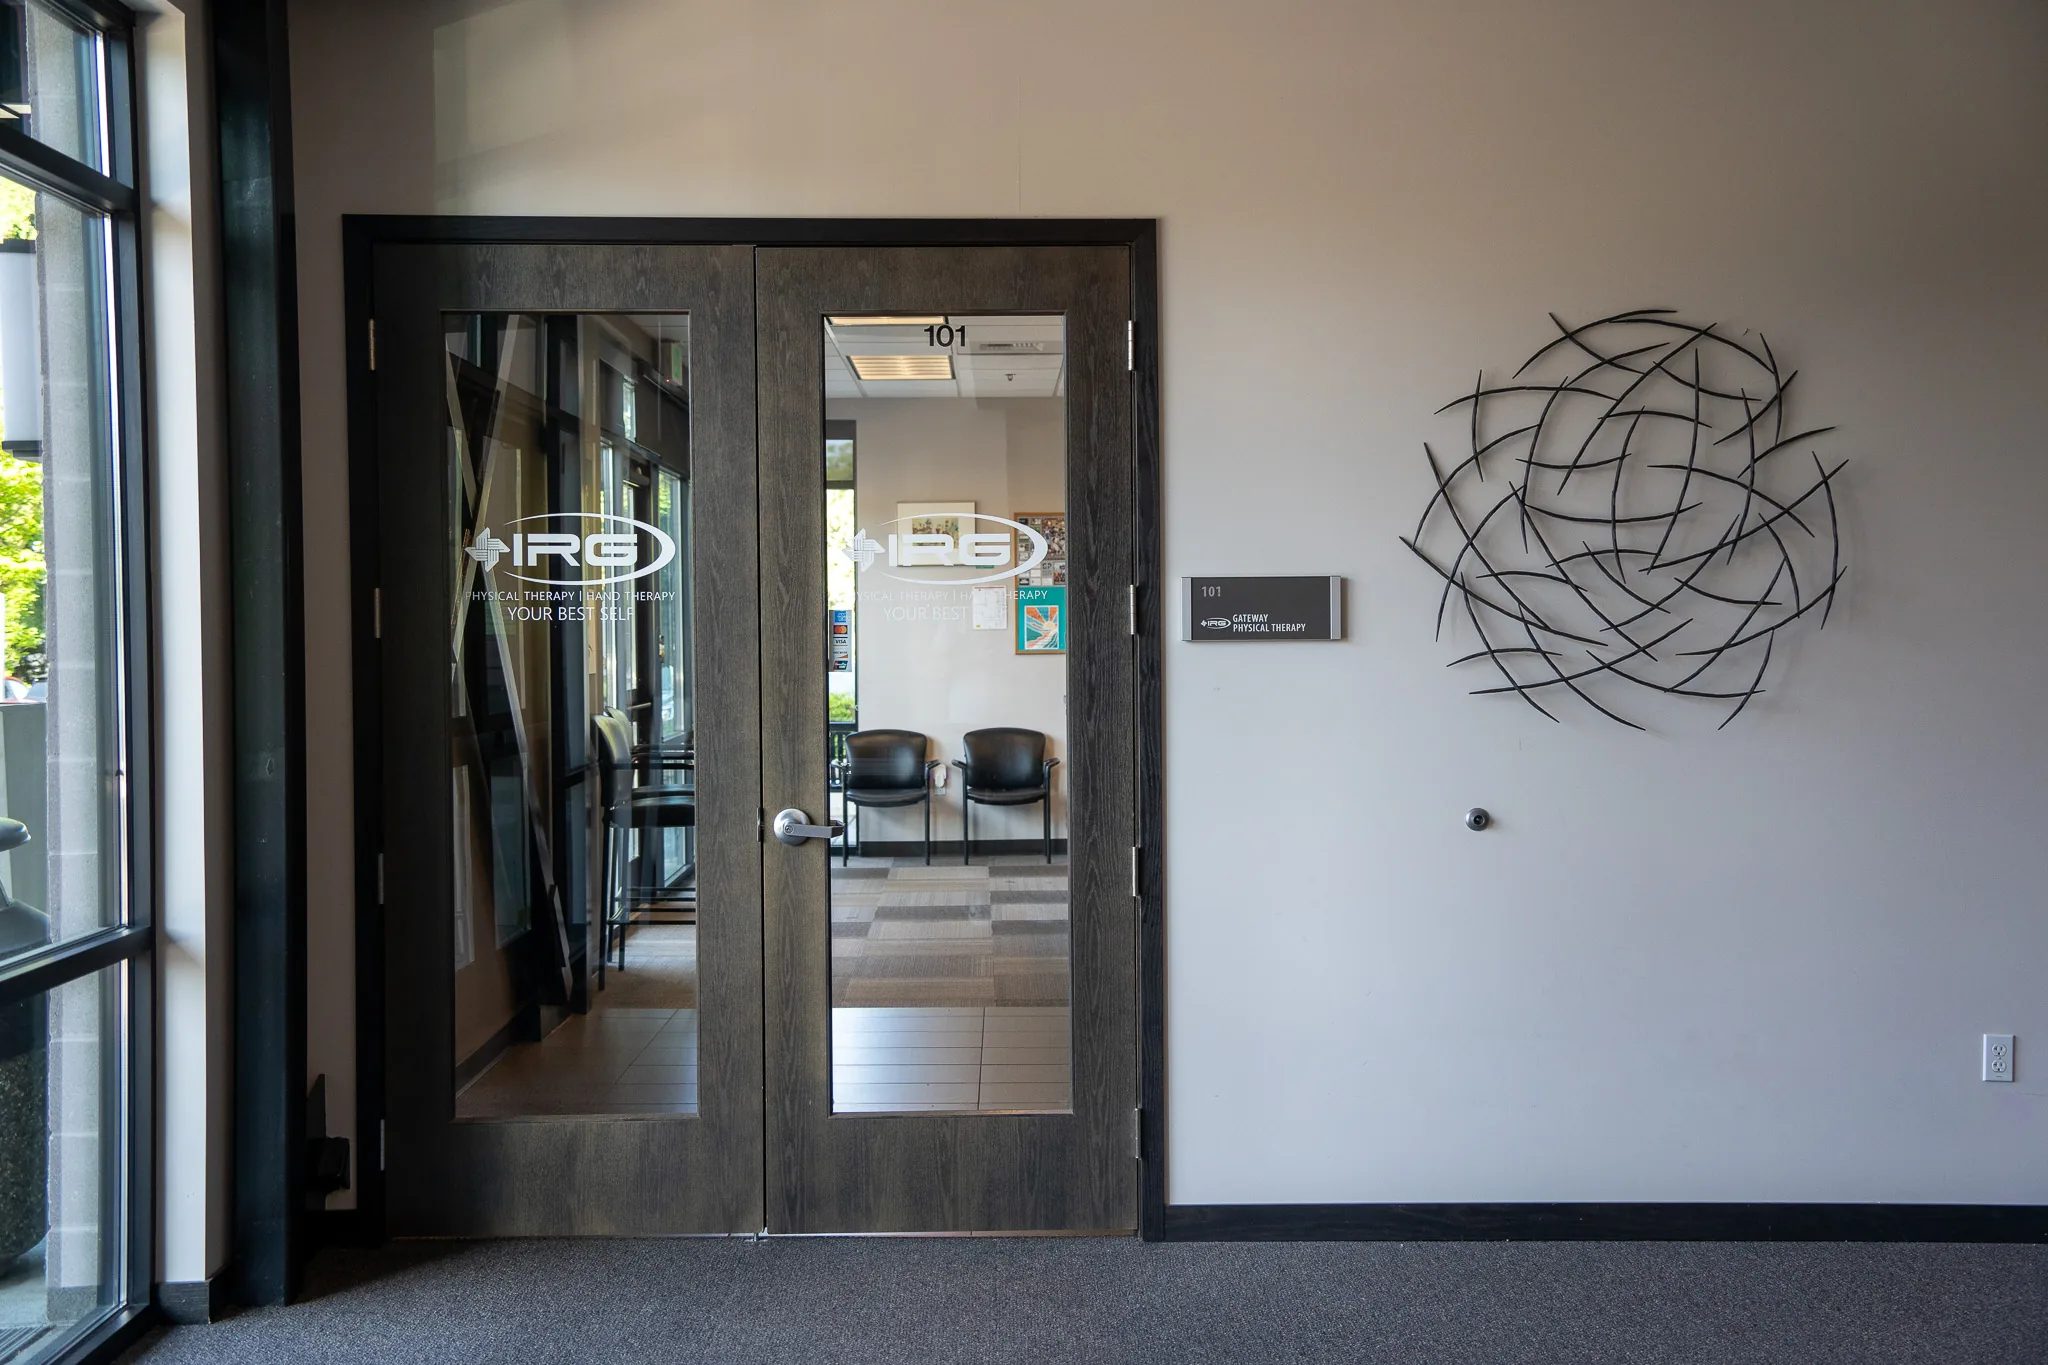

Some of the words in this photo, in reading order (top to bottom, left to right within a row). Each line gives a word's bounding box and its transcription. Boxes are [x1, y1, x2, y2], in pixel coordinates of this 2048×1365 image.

[924, 325, 966, 347] 101
[513, 533, 638, 567] IRG
[888, 533, 1011, 567] IRG
[465, 591, 520, 601] PHYSICAL
[524, 591, 575, 601] THERAPY
[586, 591, 621, 601] HAND
[625, 591, 676, 601] THERAPY
[900, 591, 949, 601] THERAPY
[1201, 586, 1222, 597] 101
[507, 606, 553, 621] YOUR
[558, 606, 595, 621] BEST
[600, 606, 634, 621] SELF
[883, 606, 928, 621] YOUR
[932, 606, 968, 621] BEST
[1232, 614, 1269, 623] GATEWAY
[1233, 623, 1270, 632] PHYSICAL
[1271, 623, 1306, 632] THERAPY
